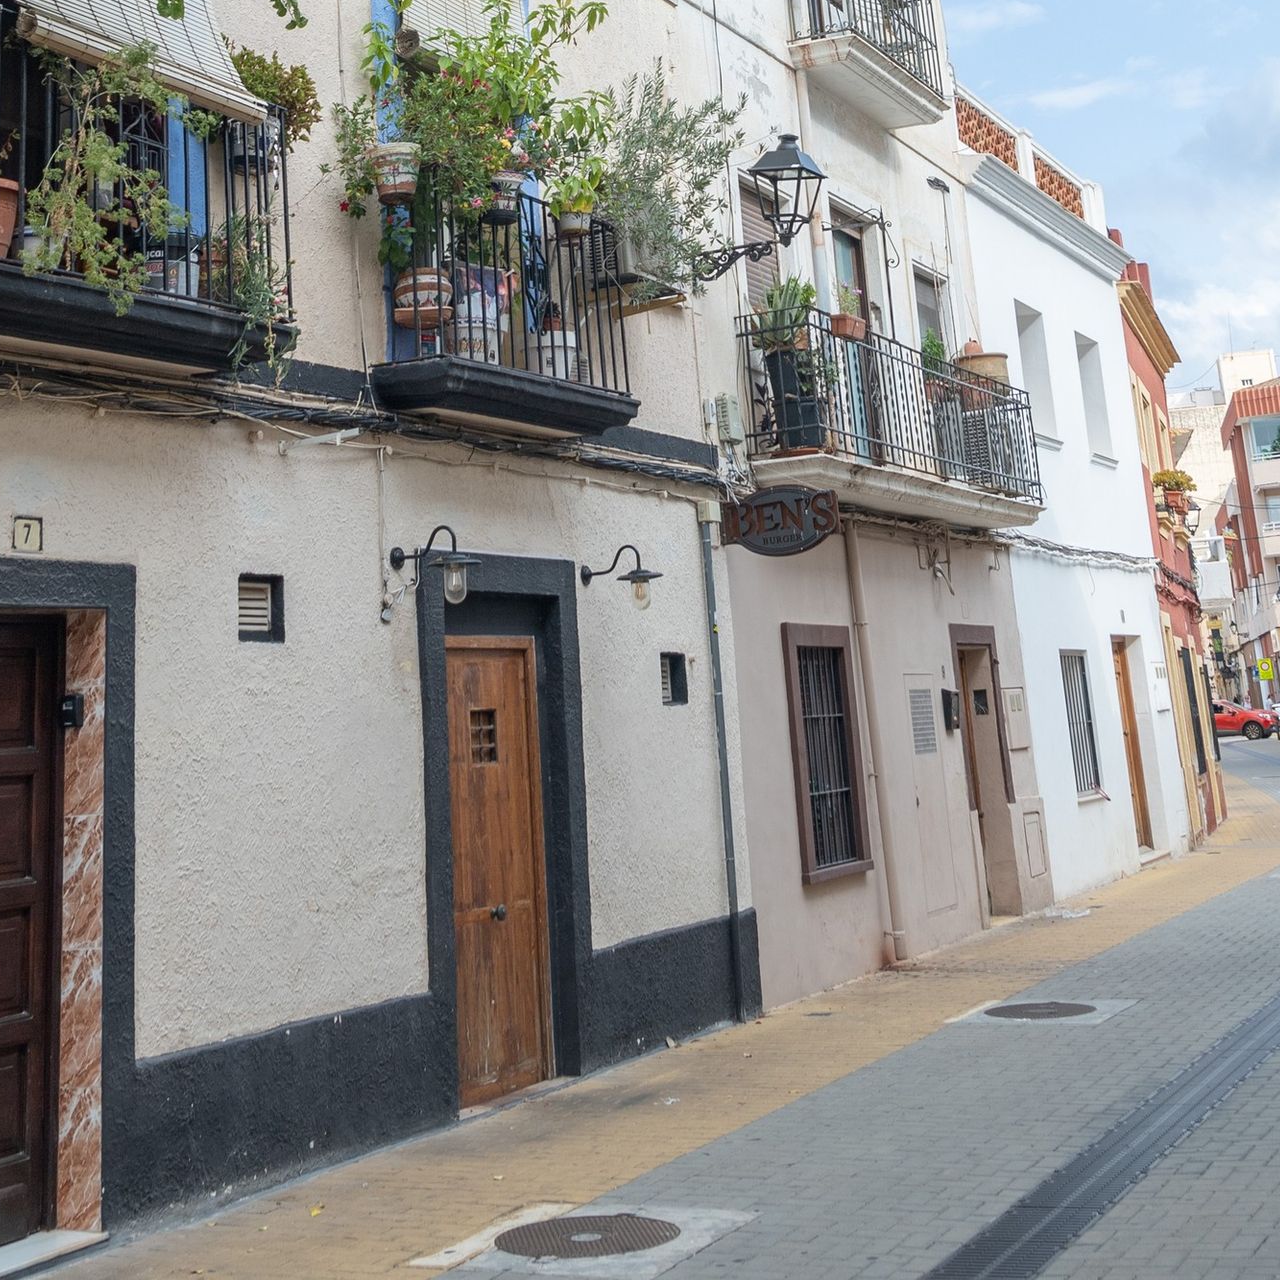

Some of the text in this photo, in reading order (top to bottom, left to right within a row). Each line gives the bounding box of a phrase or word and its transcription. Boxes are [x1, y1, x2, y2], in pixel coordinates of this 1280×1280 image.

[725, 491, 836, 539] BEN'S
[23, 522, 32, 544] 7
[762, 533, 804, 545] BURGER
